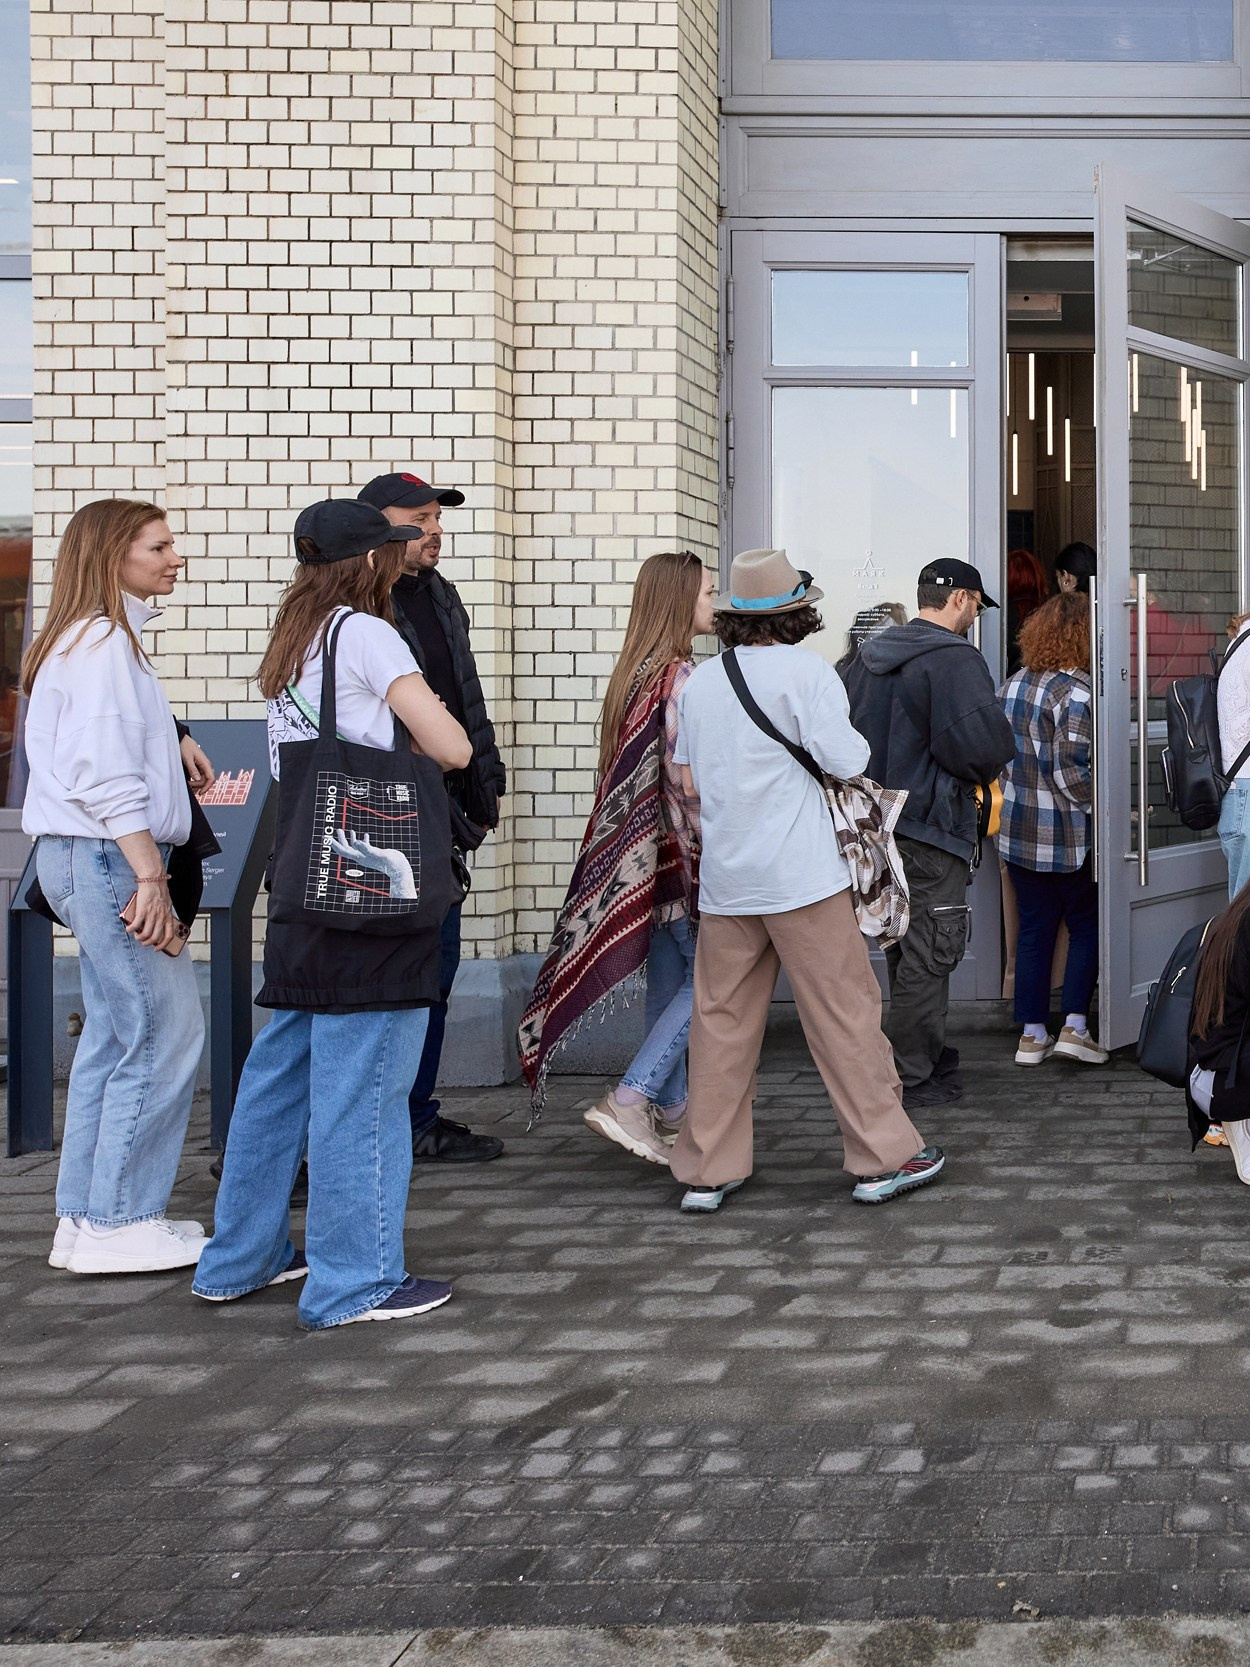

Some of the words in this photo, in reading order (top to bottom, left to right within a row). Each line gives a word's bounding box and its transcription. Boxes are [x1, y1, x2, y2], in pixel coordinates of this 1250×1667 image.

[325, 785, 338, 823] RADIO
[320, 825, 334, 865] MUSIC
[316, 867, 330, 899] TRUE
